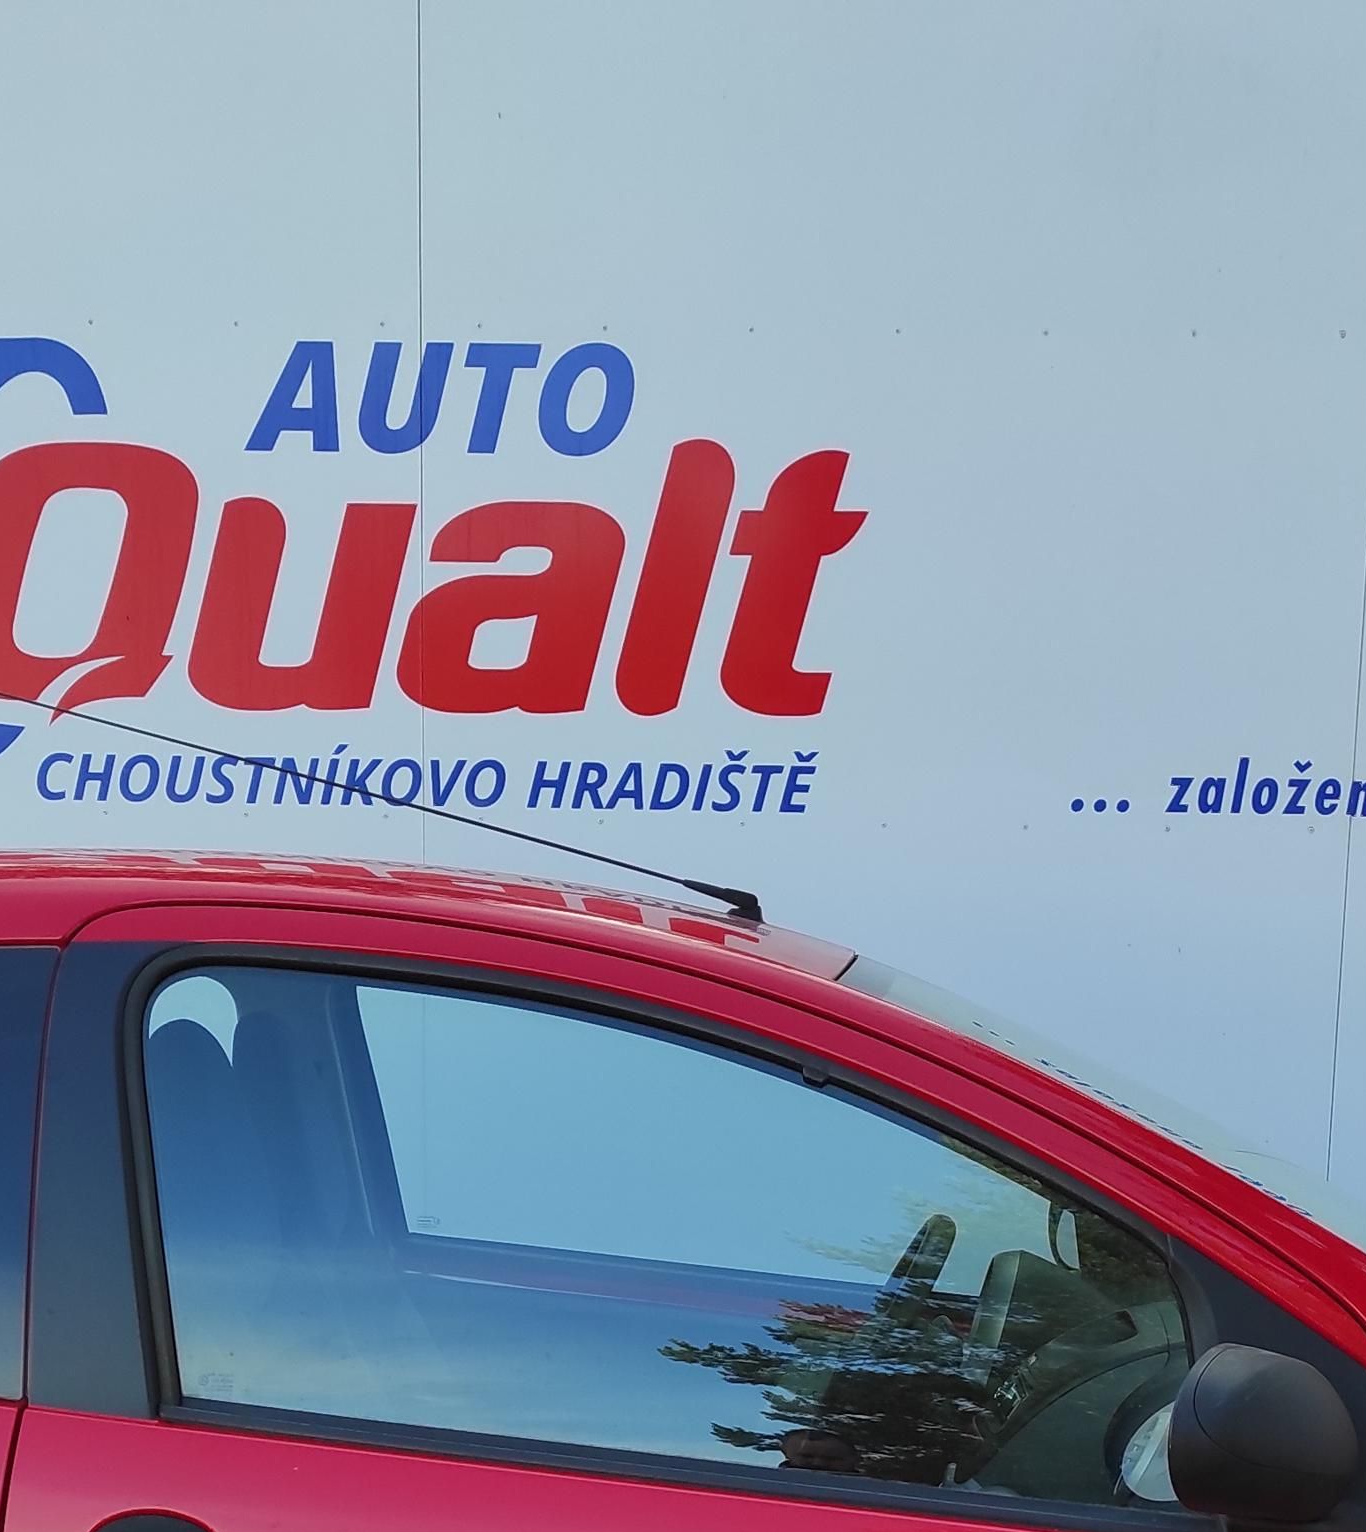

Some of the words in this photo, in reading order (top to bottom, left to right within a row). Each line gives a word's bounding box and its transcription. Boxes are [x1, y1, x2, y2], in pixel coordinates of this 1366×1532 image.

[245, 341, 635, 456] AUTO
[37, 744, 507, 808] CHOUSTNÍKOVO
[526, 751, 819, 814] HRADIŠTĚ
